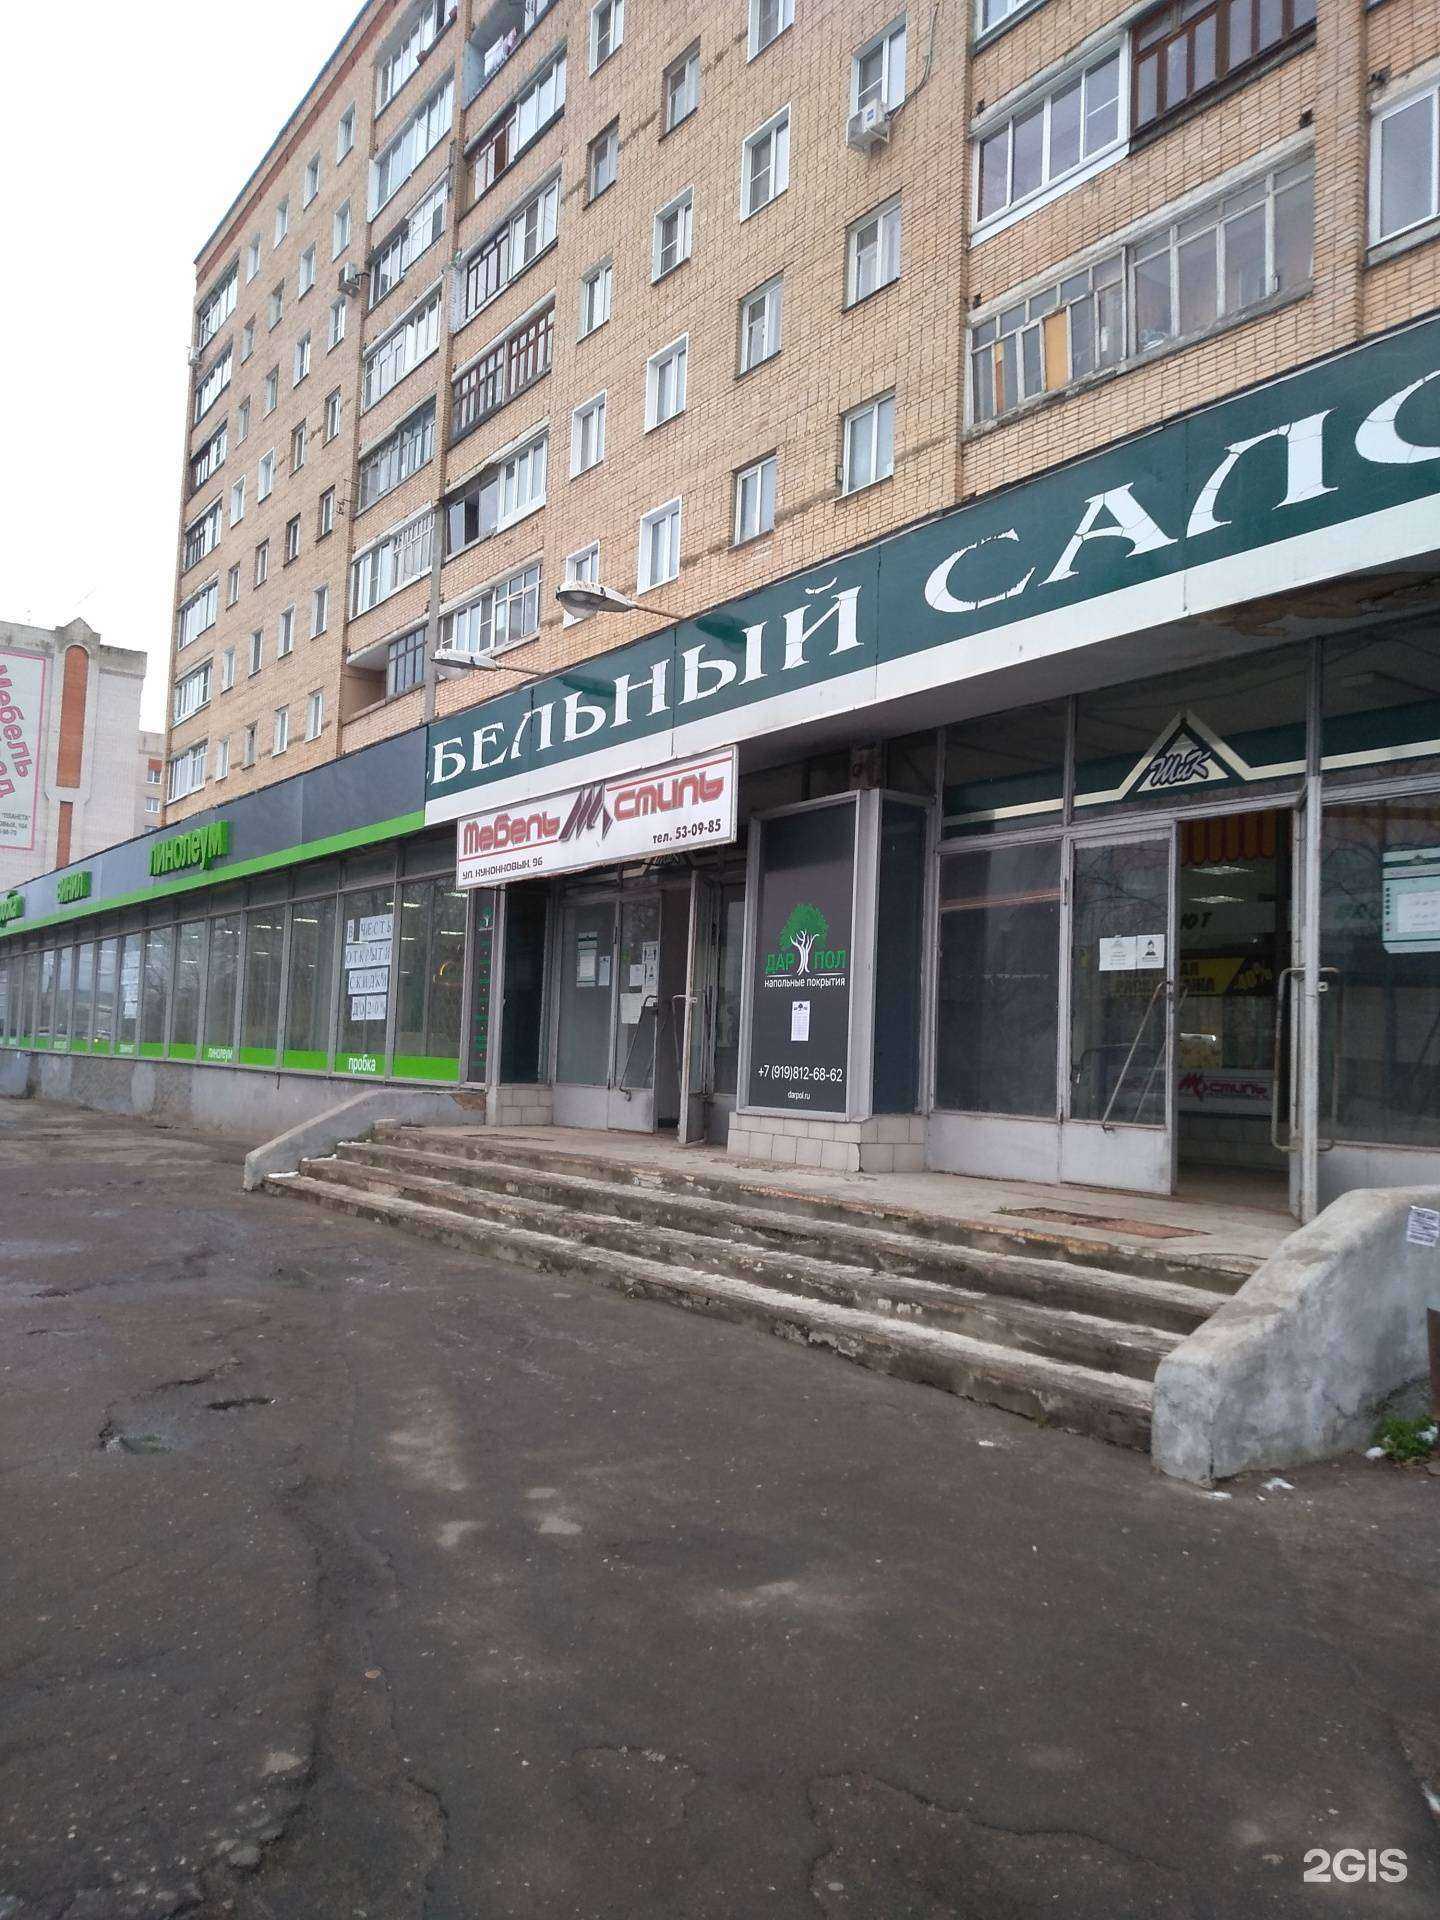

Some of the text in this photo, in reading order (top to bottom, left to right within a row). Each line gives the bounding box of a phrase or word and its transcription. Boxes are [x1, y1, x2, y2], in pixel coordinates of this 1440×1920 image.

[653, 819, 722, 844] тел. 53-09-85
[360, 919, 391, 937] ЧЕСТЬ
[766, 950, 846, 974] ДАР ПОЛ
[764, 977, 846, 988] напольные покрытия
[348, 1054, 376, 1075] пробка
[758, 1064, 843, 1082] +7 (919)812-68-62
